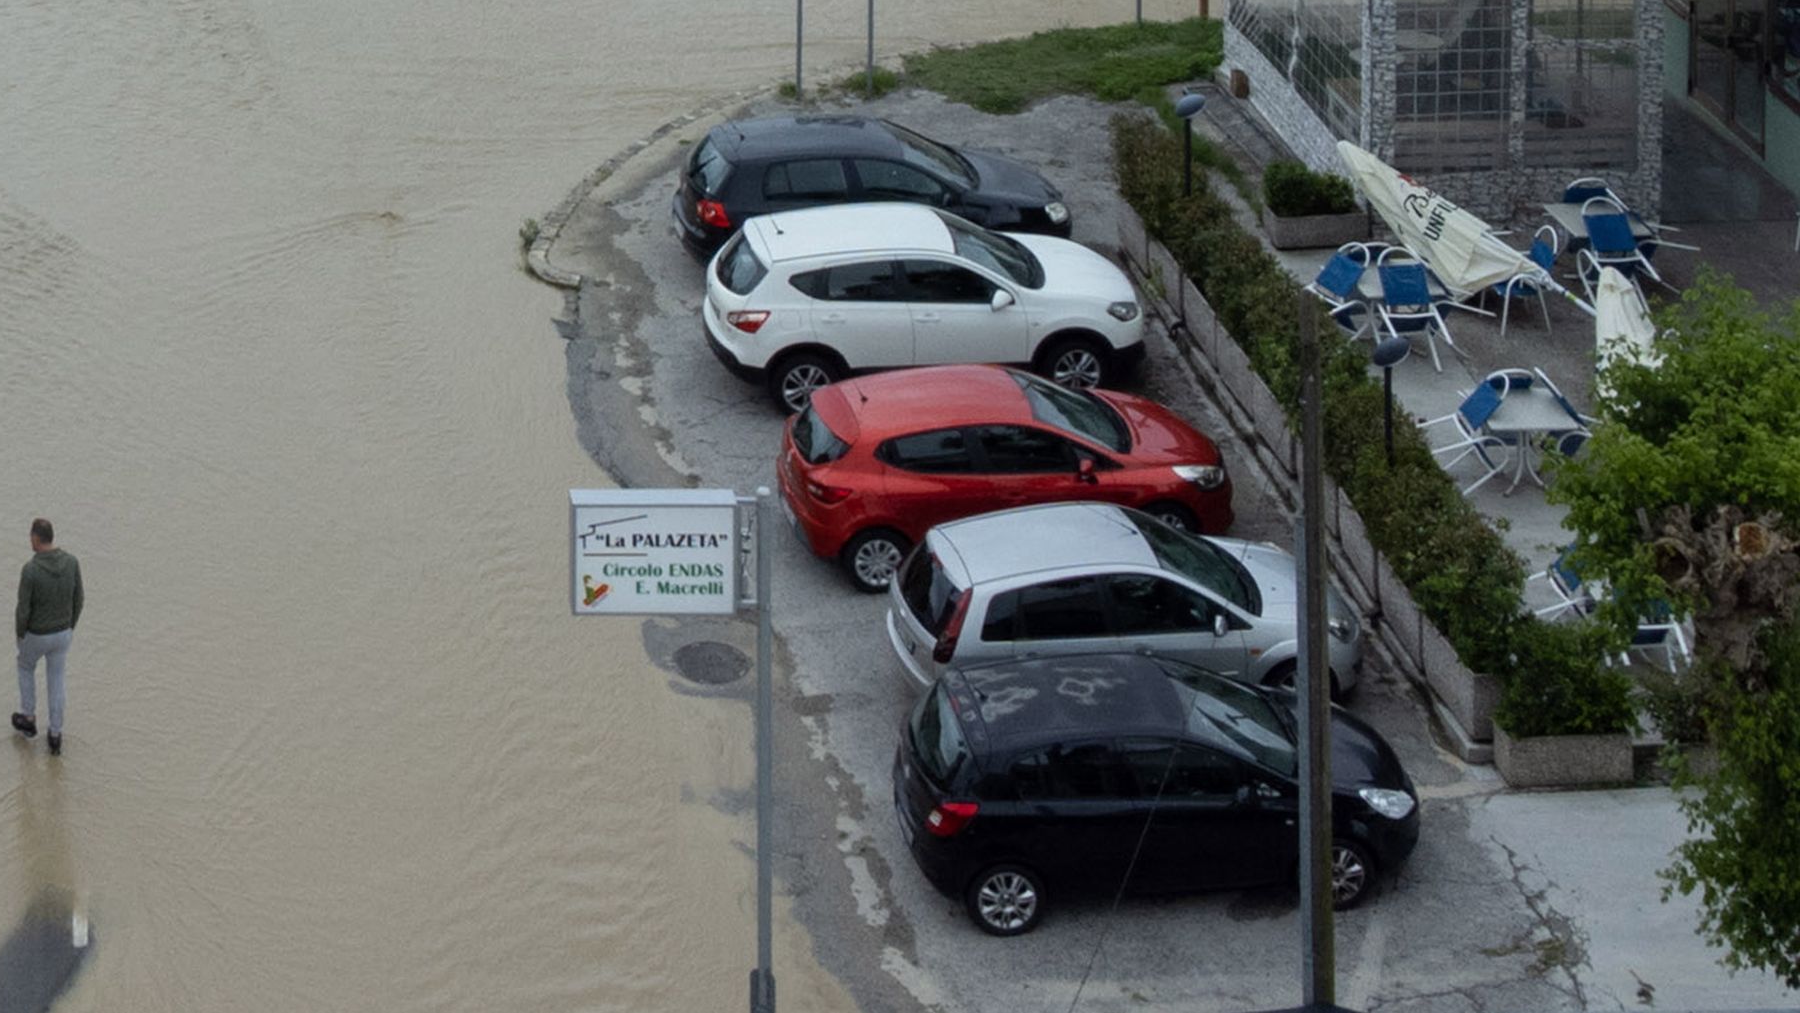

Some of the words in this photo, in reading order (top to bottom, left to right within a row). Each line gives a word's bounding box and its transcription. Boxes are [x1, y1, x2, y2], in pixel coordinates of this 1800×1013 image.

[632, 533, 728, 548] PALAZETA”
[602, 563, 663, 577] Circolo
[669, 563, 724, 577] ENDAS
[635, 581, 650, 595] E.
[656, 581, 725, 595] Macrelli
